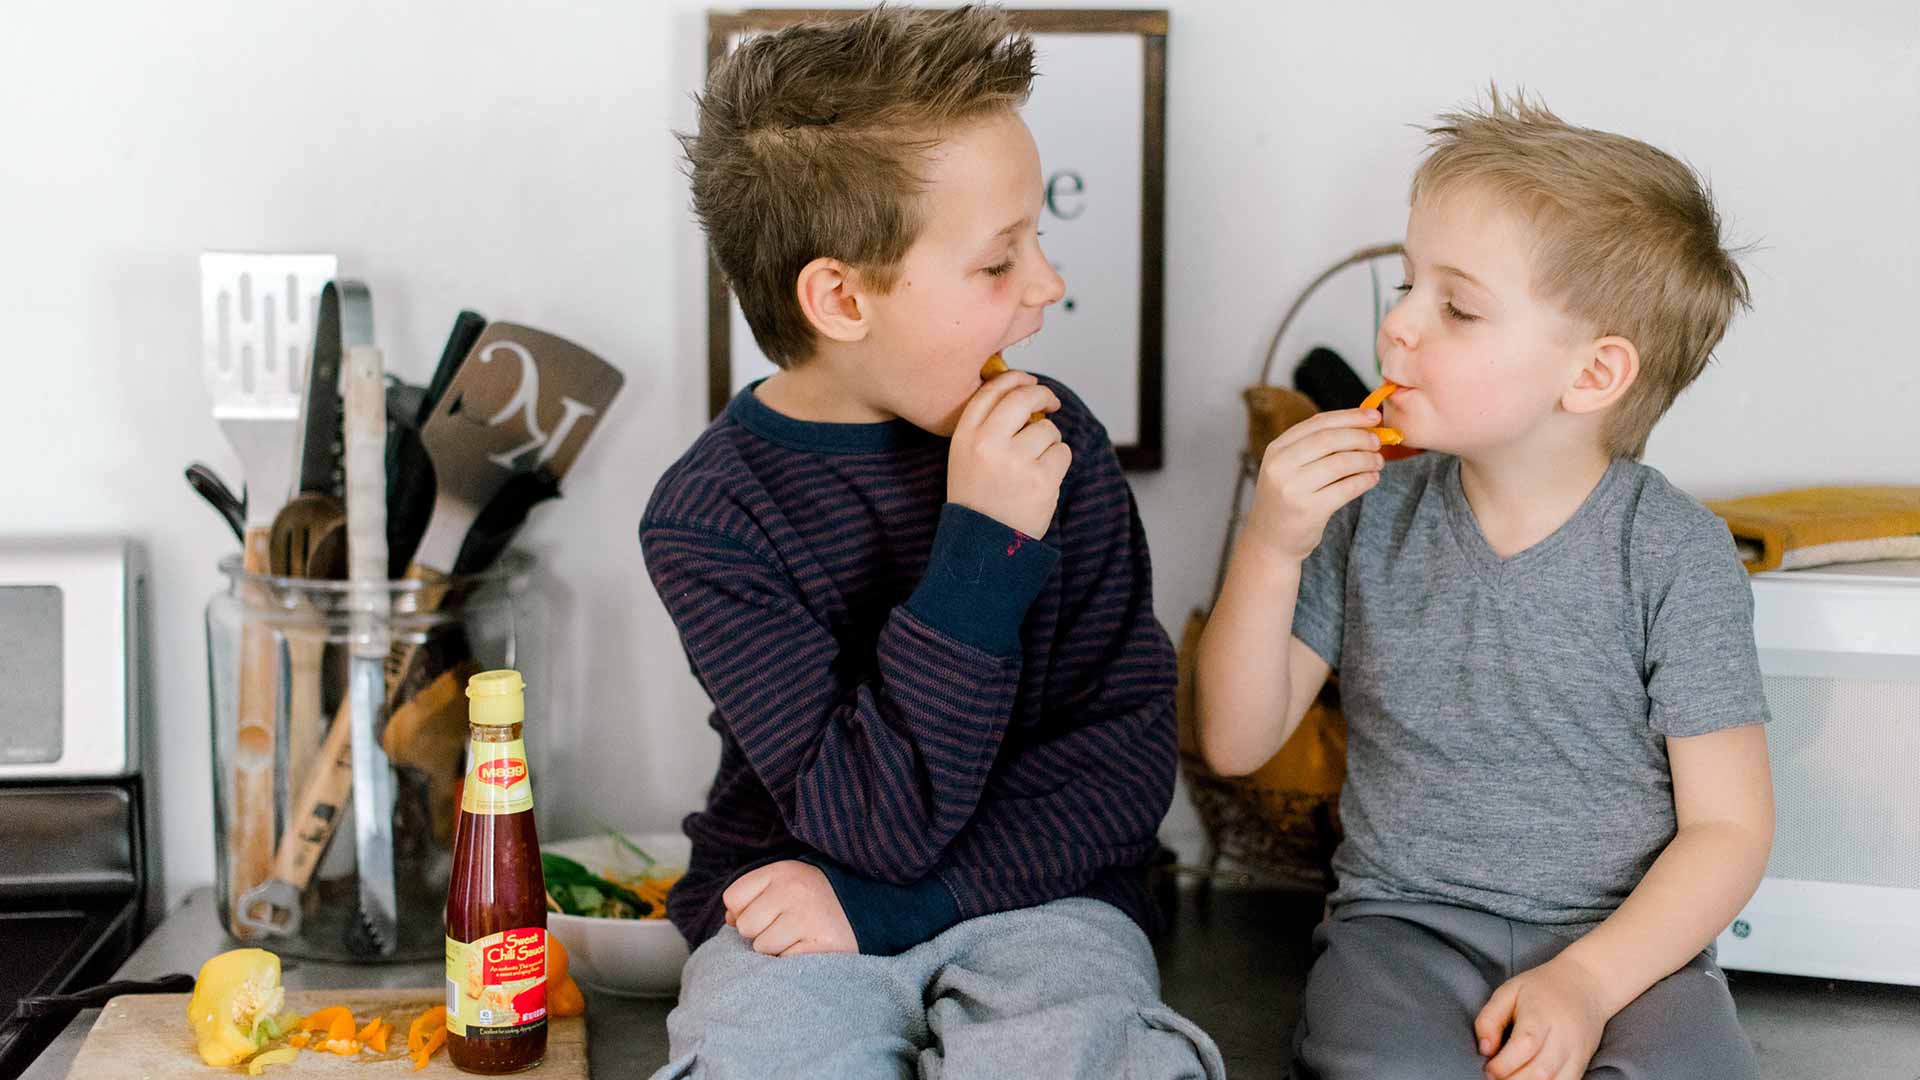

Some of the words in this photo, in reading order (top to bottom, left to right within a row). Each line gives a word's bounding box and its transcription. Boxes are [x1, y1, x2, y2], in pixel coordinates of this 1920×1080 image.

[482, 765, 525, 779] Maggi
[505, 933, 539, 949] Sweet
[487, 947, 516, 963] Chili
[516, 945, 545, 961] Sauce
